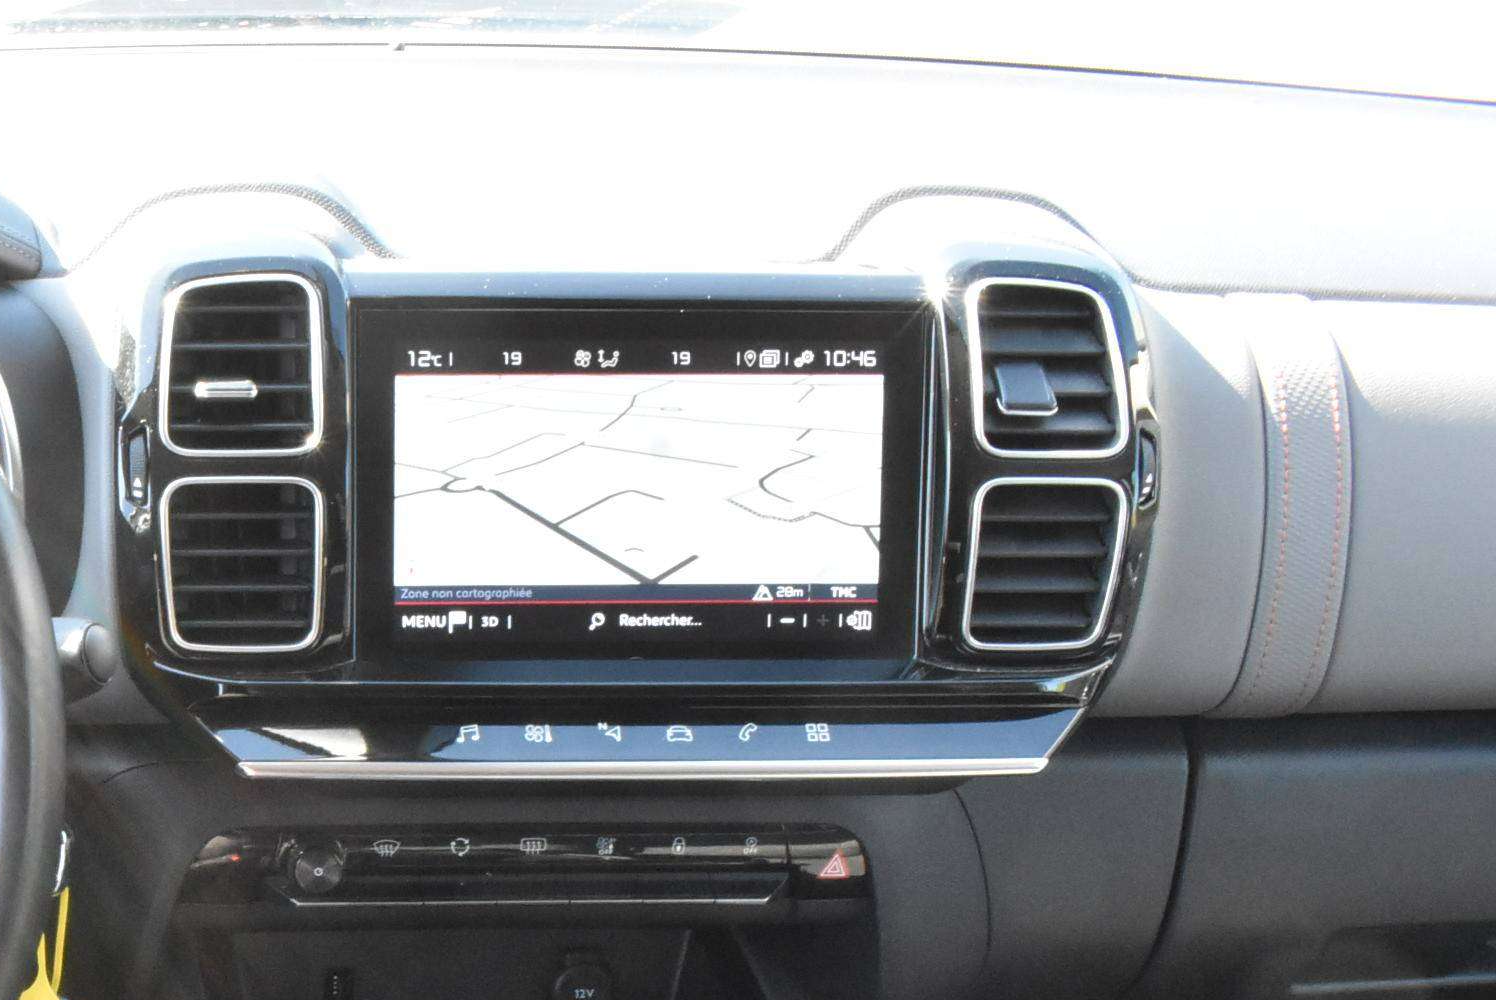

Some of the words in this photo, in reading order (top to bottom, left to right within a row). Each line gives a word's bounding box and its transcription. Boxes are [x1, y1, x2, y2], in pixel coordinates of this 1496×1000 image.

[503, 351, 522, 366] 19
[671, 351, 691, 366] 19
[823, 350, 877, 367] 10:46
[400, 588, 429, 599] Zone
[431, 590, 453, 598] non
[456, 587, 533, 600] cartographiée
[831, 586, 857, 598] TMC
[401, 615, 447, 628] MENU
[481, 615, 499, 628] 3D
[619, 613, 702, 627] Rechercher...
[574, 988, 595, 999] 12V
